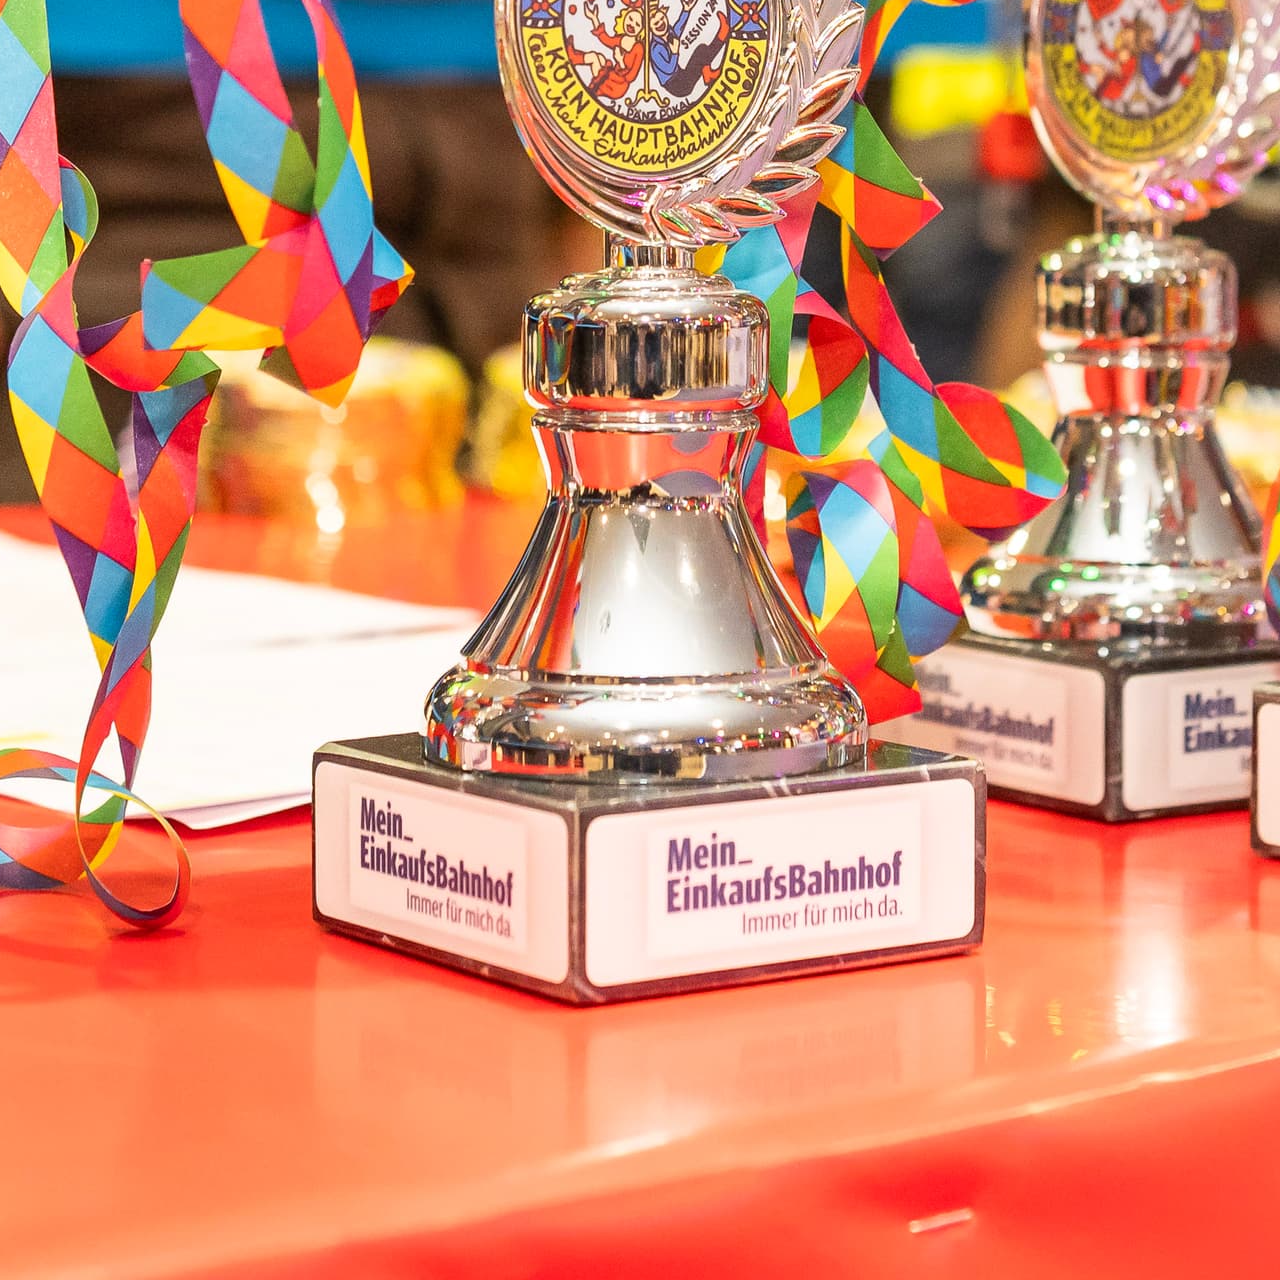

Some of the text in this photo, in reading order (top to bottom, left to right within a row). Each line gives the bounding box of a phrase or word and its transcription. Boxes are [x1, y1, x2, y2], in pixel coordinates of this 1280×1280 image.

[681, 9, 712, 50] SESSION
[546, 47, 746, 150] KÖLN HAUPTBAHNHOF
[546, 89, 588, 142] Mein
[360, 796, 414, 842] Mein_
[360, 834, 513, 908] EinkaufsBahnhof
[667, 832, 753, 873] Mein_
[667, 850, 902, 914] EinkaufsBahnhof
[406, 887, 443, 920] Immer
[446, 898, 463, 924] für
[465, 906, 494, 933] mich
[742, 894, 903, 935] Immer für mich da.
